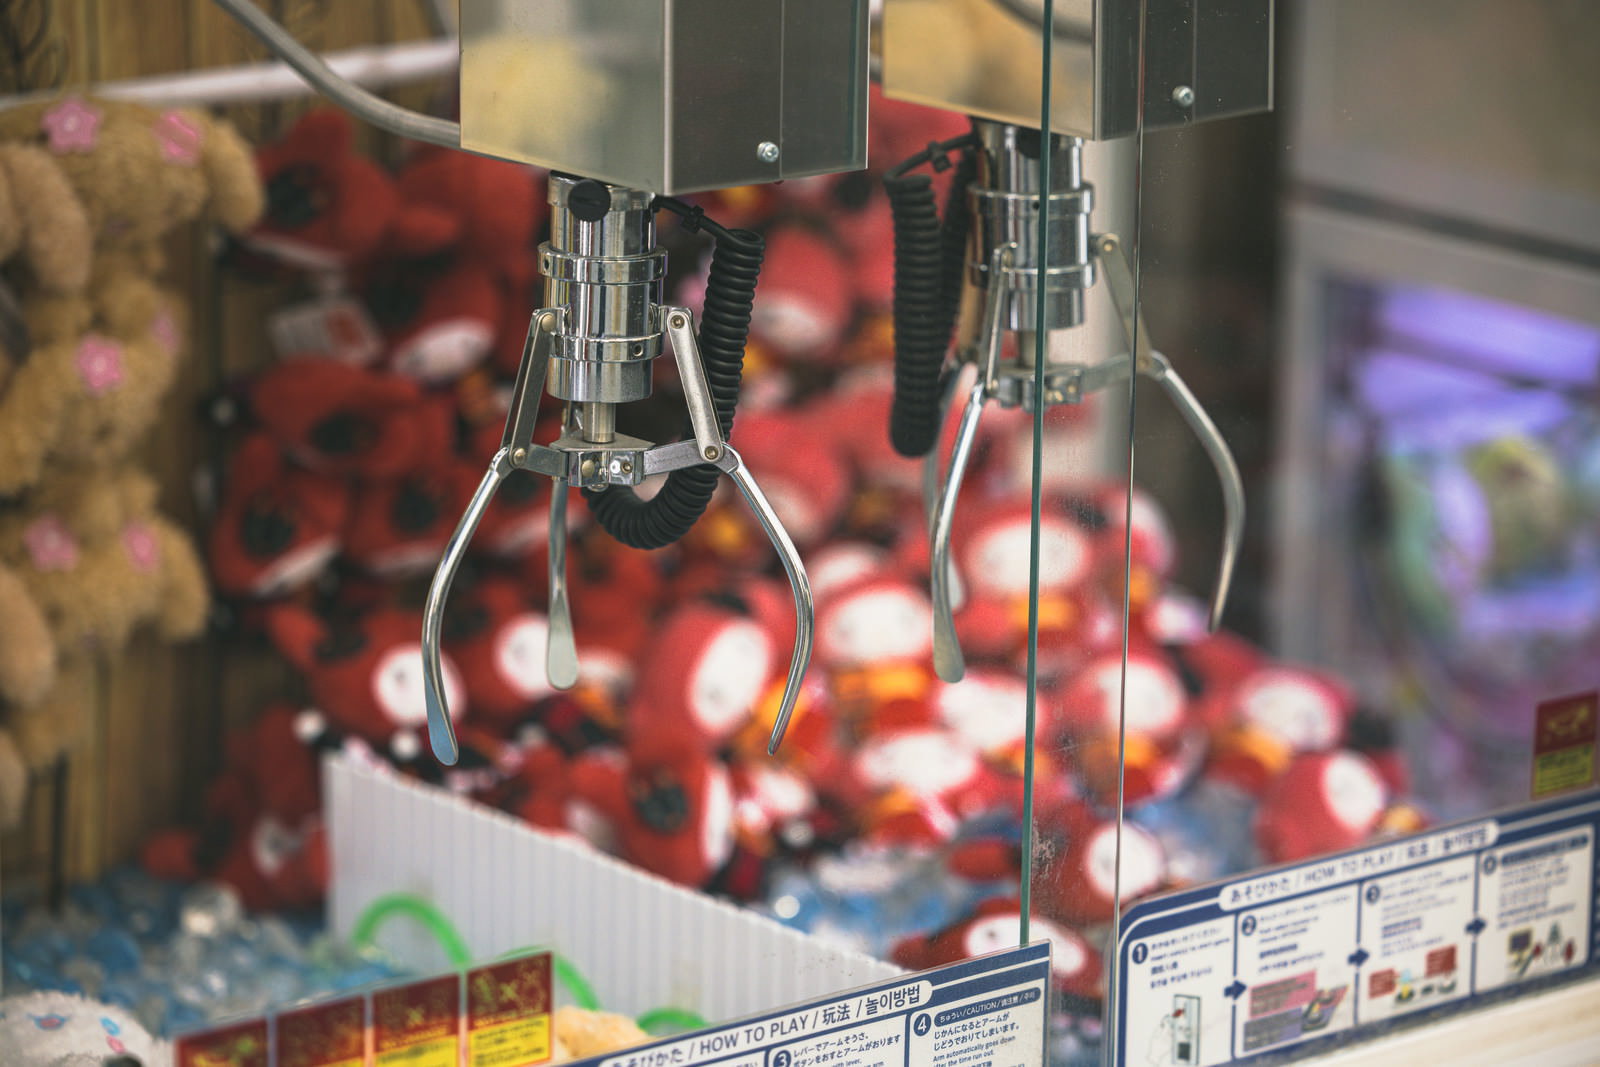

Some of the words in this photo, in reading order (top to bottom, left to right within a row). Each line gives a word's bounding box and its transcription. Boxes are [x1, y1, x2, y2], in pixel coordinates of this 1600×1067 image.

[1303, 866, 1335, 883] HOW
[1362, 850, 1393, 870] PLAY
[1136, 946, 1144, 962] 1
[700, 1032, 740, 1055] HOW
[744, 1026, 765, 1044] TO
[770, 1015, 809, 1038] PLAY
[822, 1003, 850, 1025] 玩法
[865, 984, 921, 1015] 놀이방법
[917, 1016, 927, 1033] 4
[934, 1012, 1010, 1040] じかんになるとアームが
[793, 1032, 869, 1058] レバーでアームそうさ。
[933, 1055, 945, 1063] Arm
[946, 1043, 984, 1060] automatically
[985, 1040, 998, 1051] goes
[778, 1053, 787, 1067] 3
